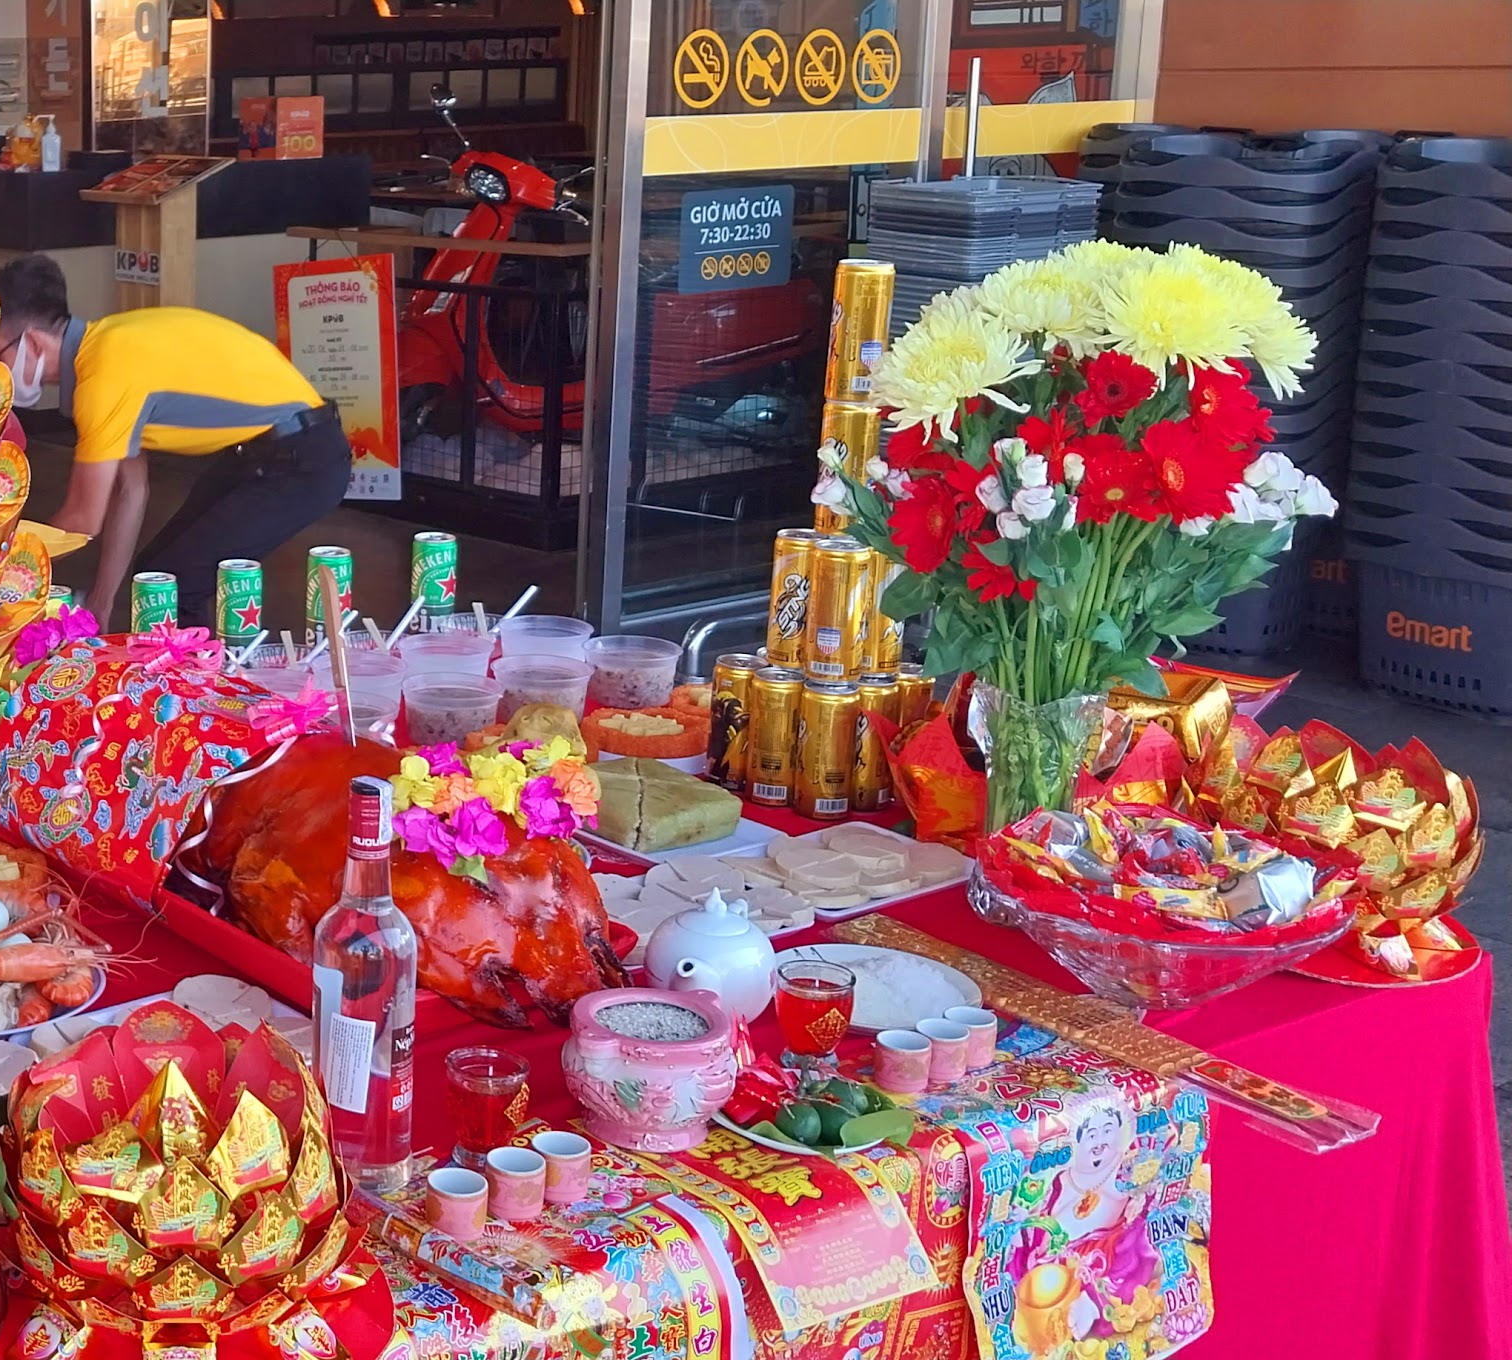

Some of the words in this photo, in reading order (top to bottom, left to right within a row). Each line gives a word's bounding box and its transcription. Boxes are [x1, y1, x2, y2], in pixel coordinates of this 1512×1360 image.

[690, 201, 720, 224] GIỜ
[722, 197, 750, 221] MỞ
[751, 195, 782, 218] CỬA
[701, 223, 771, 245] 7:30-22:30
[1386, 609, 1473, 652] emart
